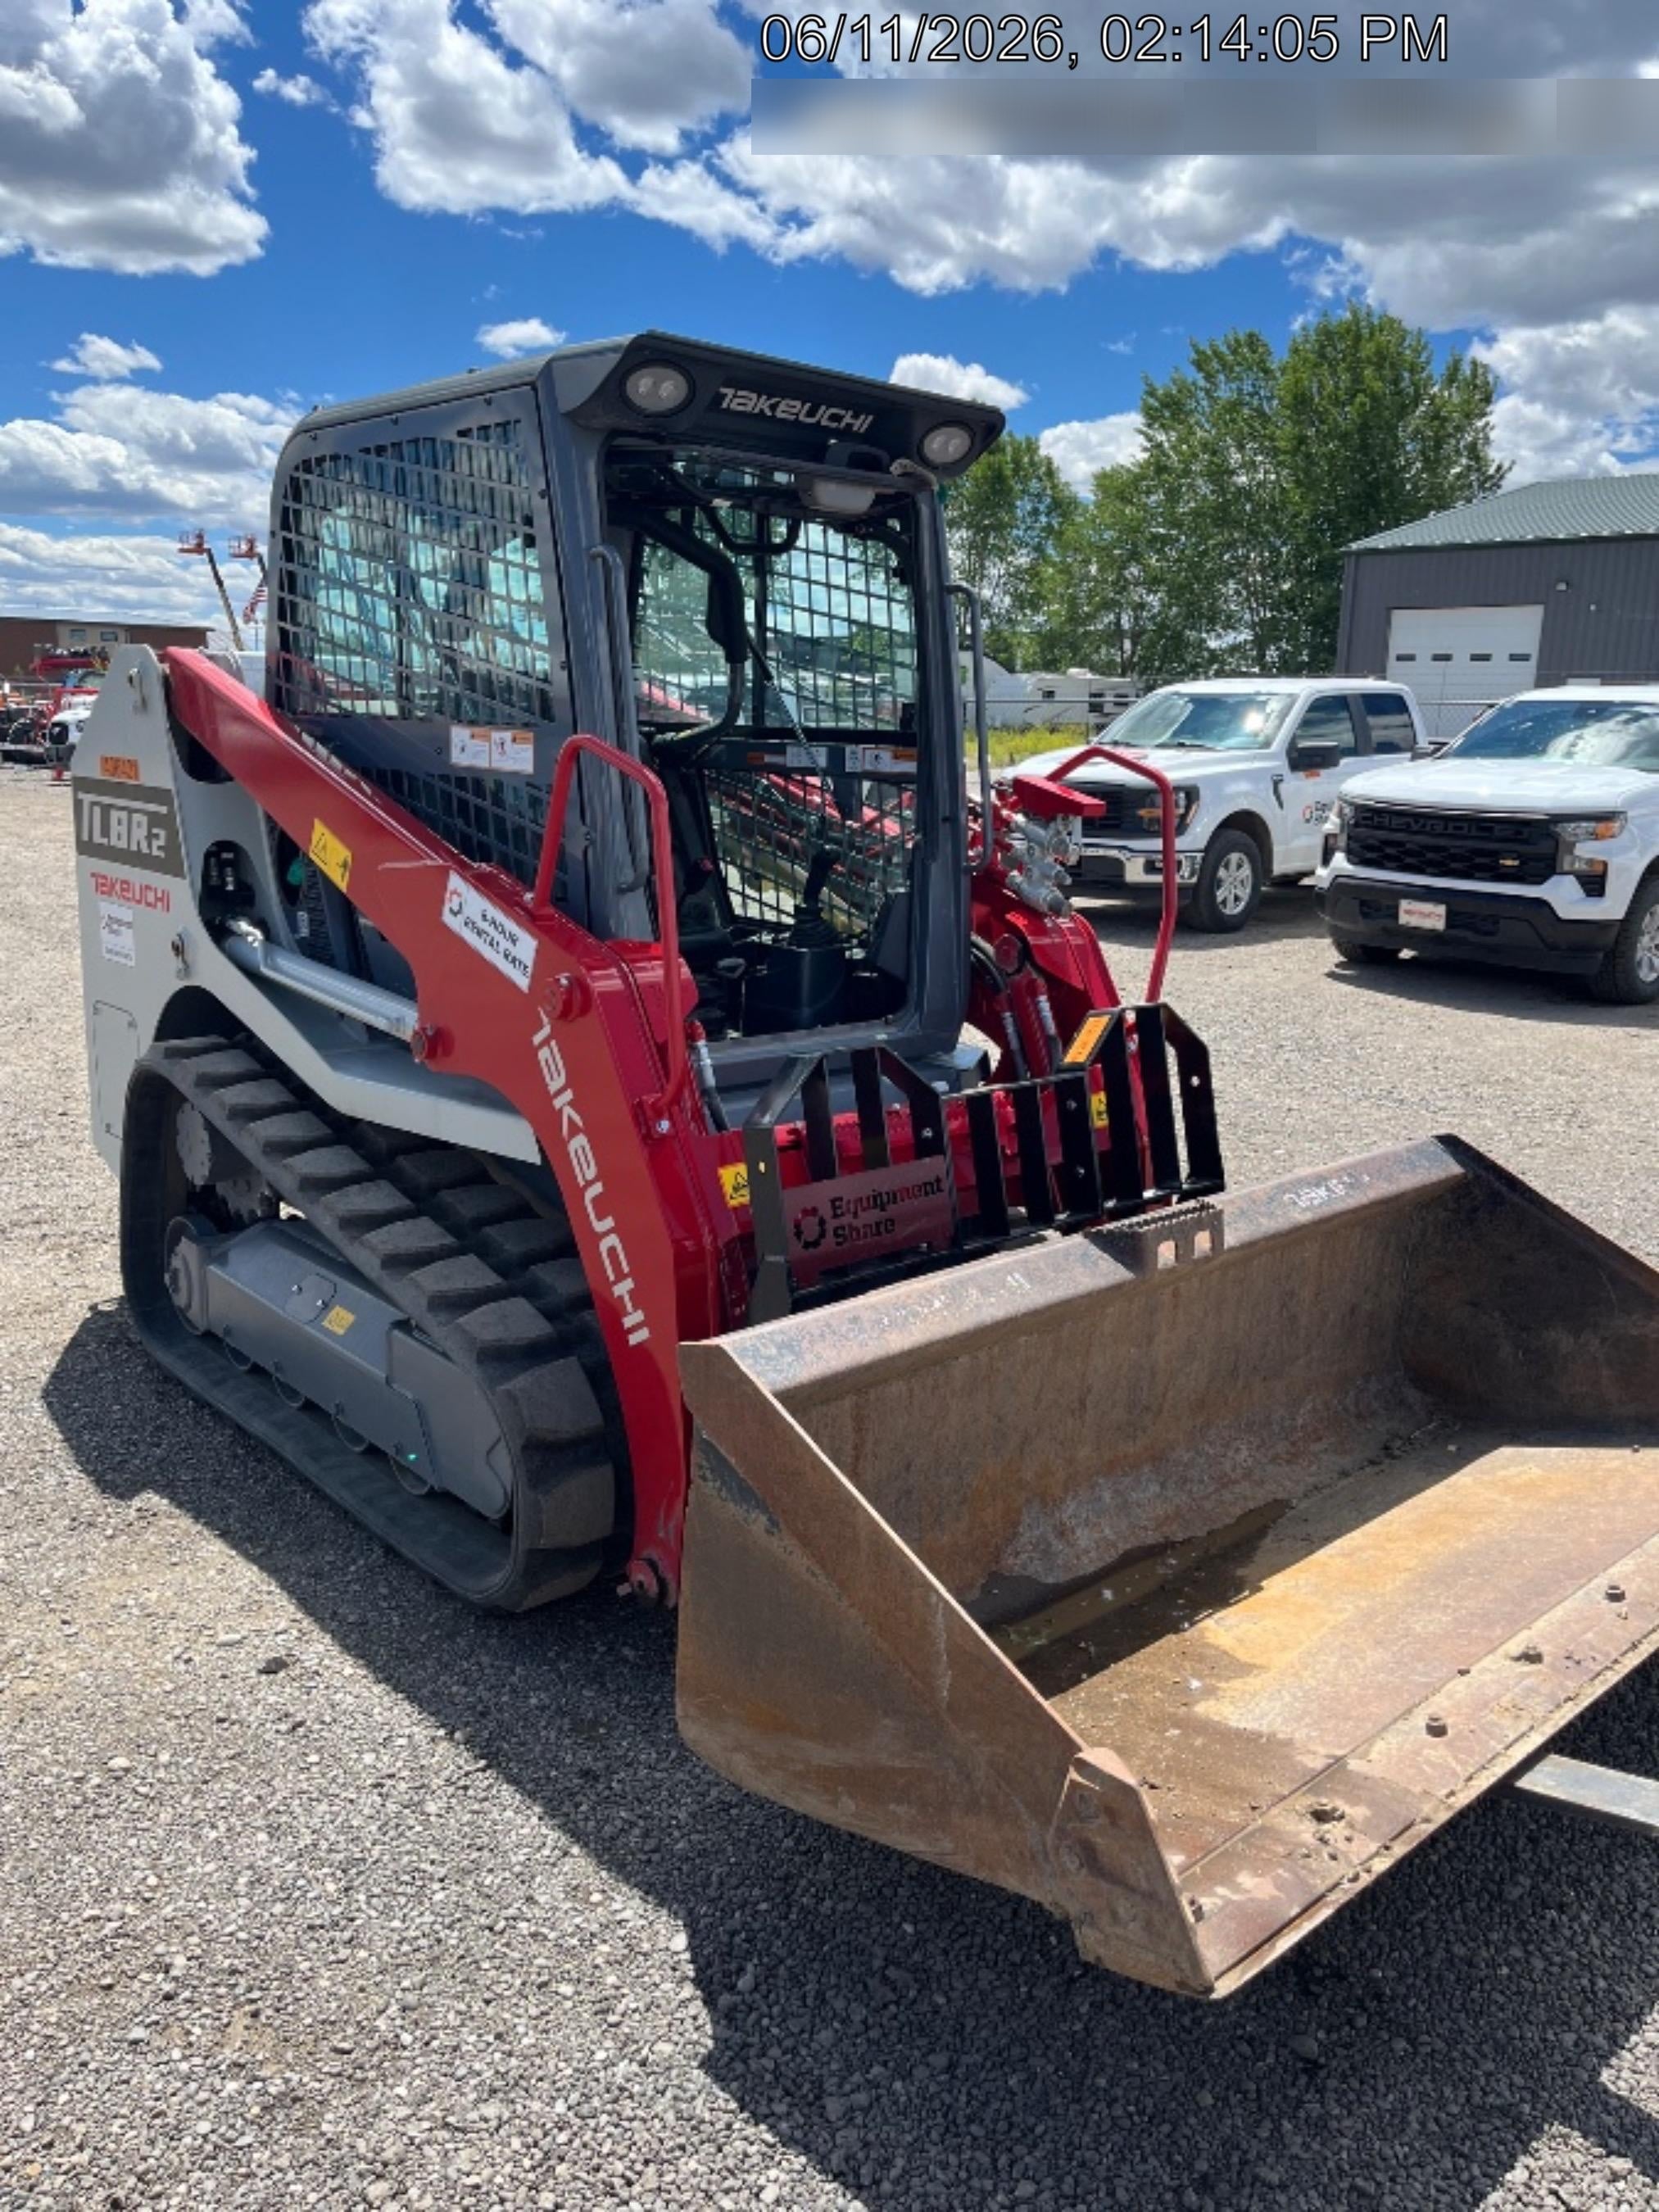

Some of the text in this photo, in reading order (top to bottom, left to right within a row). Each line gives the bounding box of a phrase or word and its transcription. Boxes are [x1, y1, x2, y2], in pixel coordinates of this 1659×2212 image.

[718, 386, 874, 433] TAKEUCHI
[1358, 811, 1530, 841] CHEVROLET
[90, 871, 170, 913] TAKEUCHI
[463, 916, 530, 979] RENTAL RATE
[531, 1006, 652, 1348] TAKEUCHI
[828, 1173, 945, 1221] Equipment
[832, 1217, 896, 1247] Share
